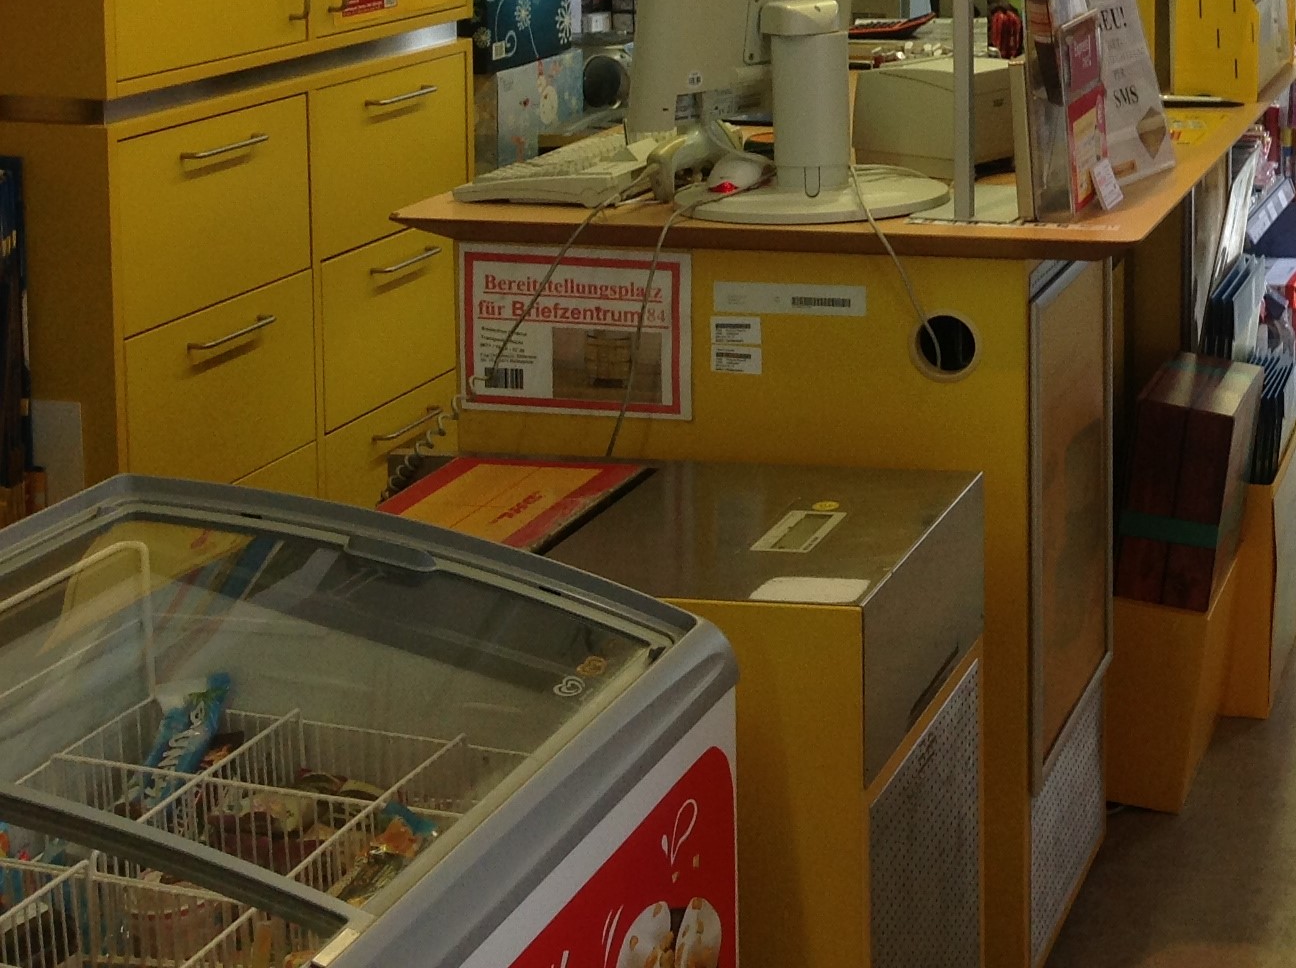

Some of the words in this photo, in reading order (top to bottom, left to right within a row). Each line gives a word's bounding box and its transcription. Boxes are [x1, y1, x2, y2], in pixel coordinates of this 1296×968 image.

[1099, 6, 1128, 33] EU!
[1112, 84, 1140, 109] SMS
[484, 273, 663, 302] Bereittellungsplaz
[478, 299, 506, 317] für
[647, 307, 666, 323] 84
